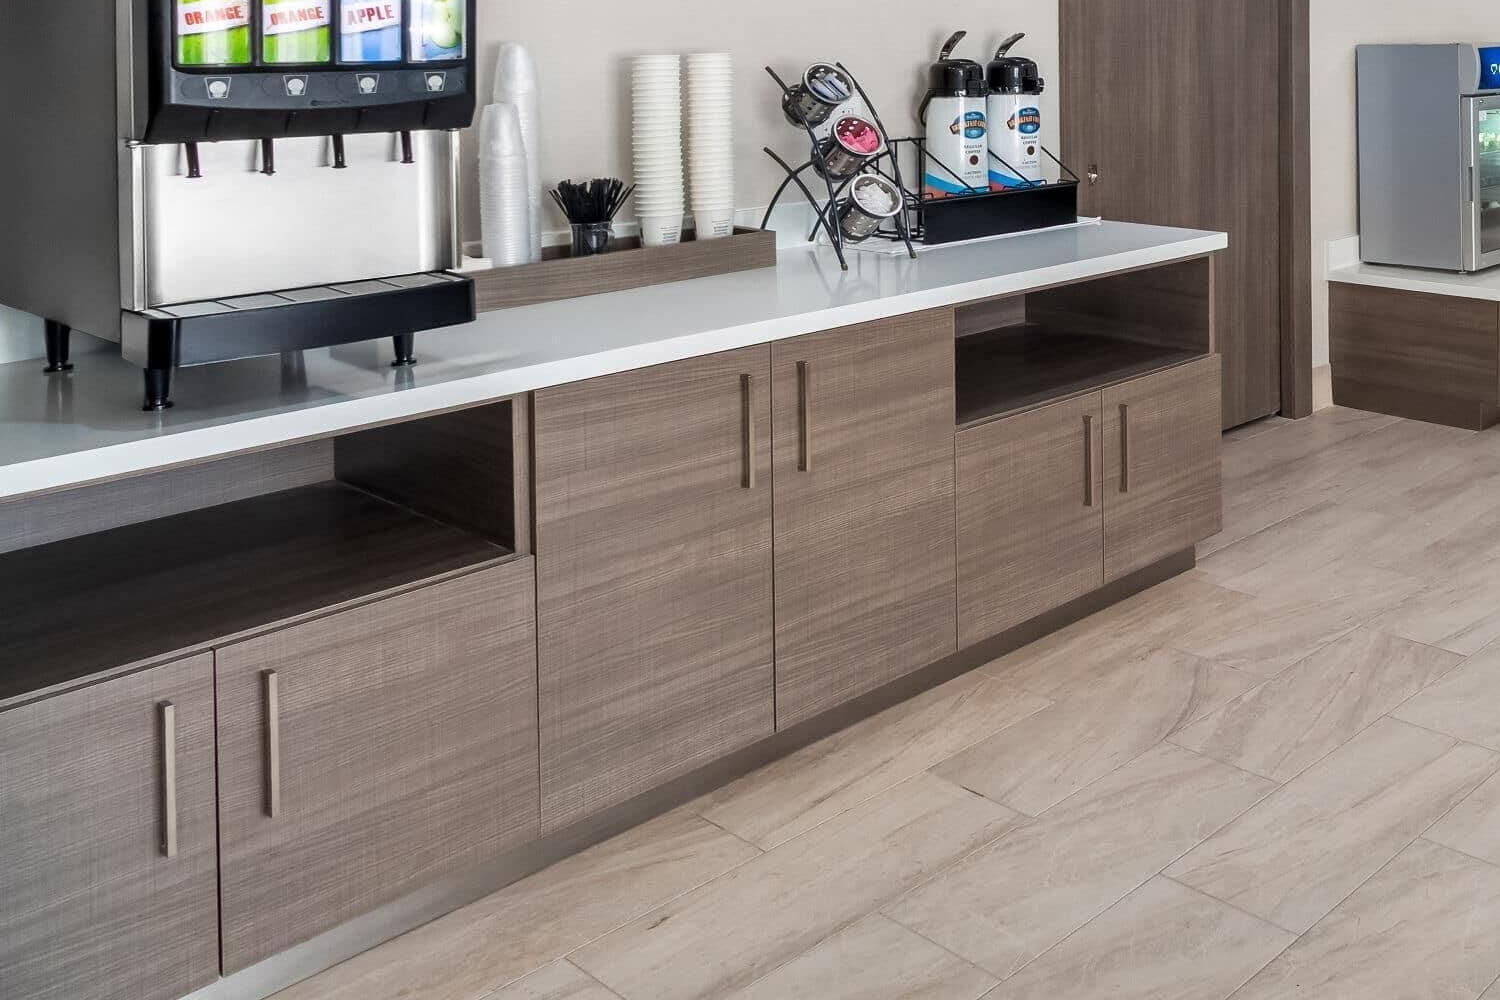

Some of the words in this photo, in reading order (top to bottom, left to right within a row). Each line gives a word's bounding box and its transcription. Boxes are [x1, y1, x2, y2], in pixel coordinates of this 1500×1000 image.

[184, 5, 244, 26] ORANGE
[269, 6, 325, 26] ORANGE
[346, 4, 395, 24] APPLE
